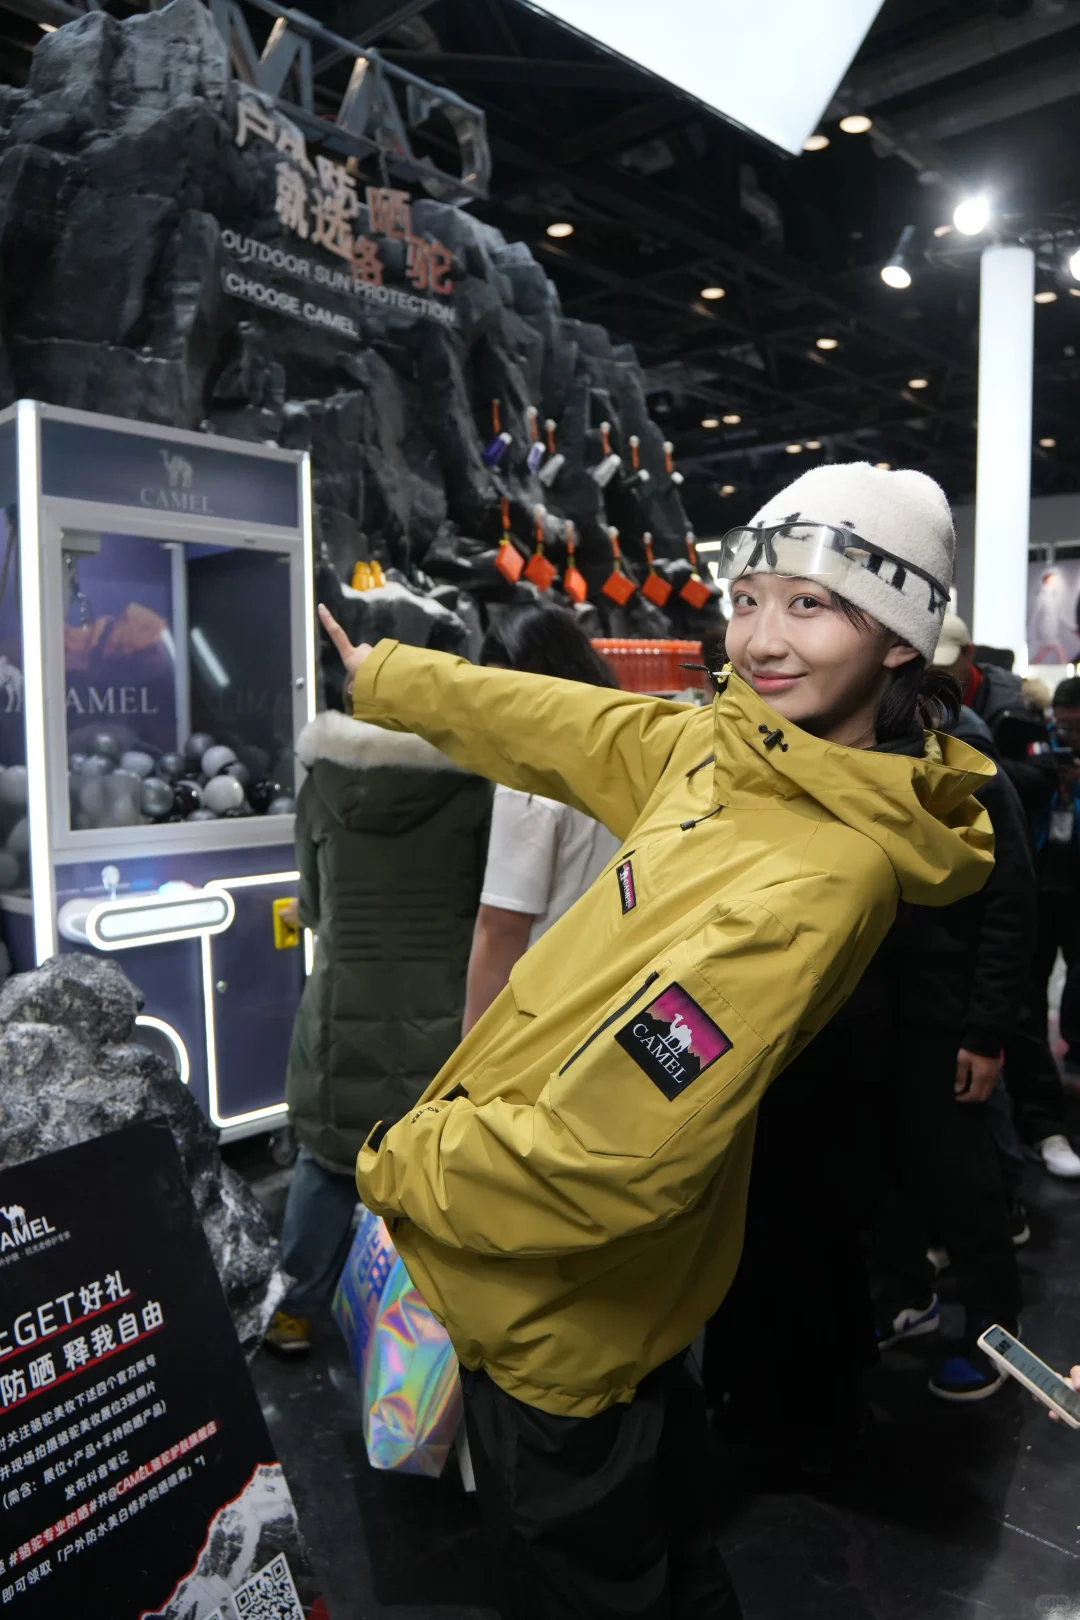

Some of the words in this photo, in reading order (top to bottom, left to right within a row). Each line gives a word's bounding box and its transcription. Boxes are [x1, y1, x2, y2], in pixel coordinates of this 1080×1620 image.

[221, 228, 311, 279] OUTDOOR
[313, 263, 351, 291] SUN
[354, 280, 457, 324] PROTECTION
[225, 272, 301, 317] CHOOSE
[302, 302, 358, 339] CAMEL
[140, 486, 215, 514] CAMEL
[66, 686, 159, 716] AMEL
[632, 1022, 688, 1084] CAMEL
[0, 1216, 56, 1252] AMEL
[0, 1352, 57, 1408] 防晒
[62, 1300, 165, 1372] 释我自由
[64, 1450, 131, 1501] 发布抖音笔记
